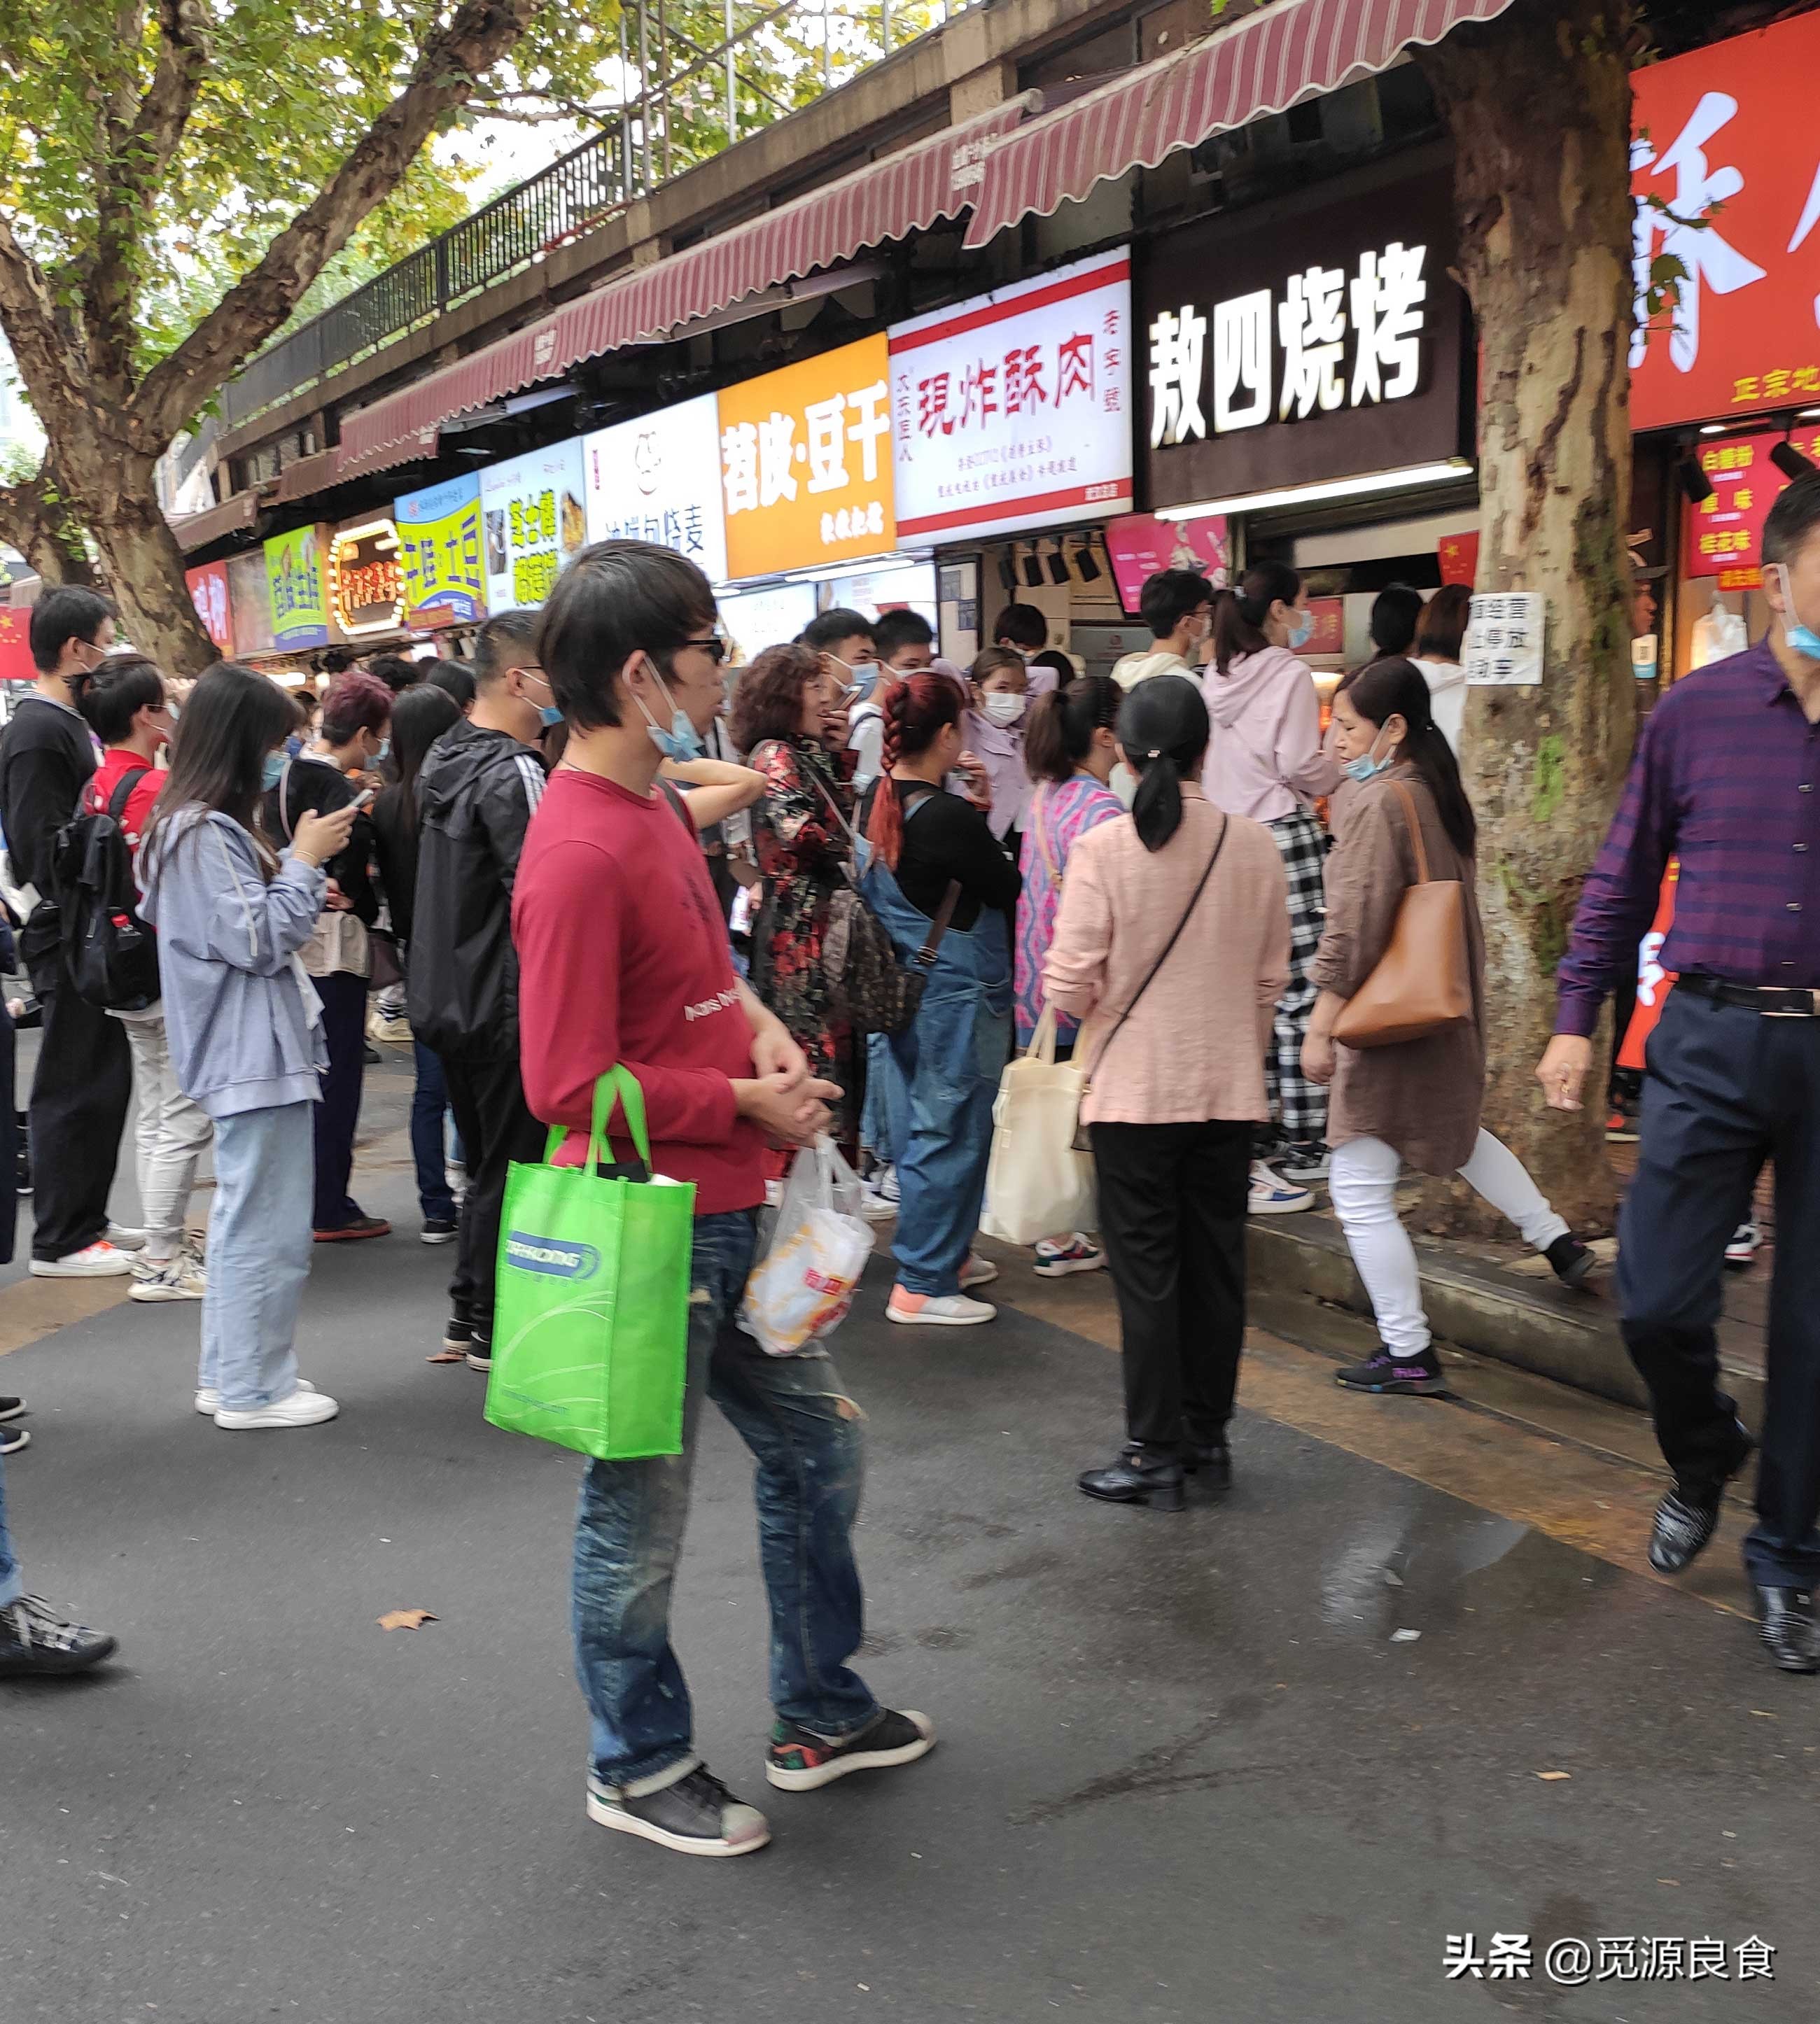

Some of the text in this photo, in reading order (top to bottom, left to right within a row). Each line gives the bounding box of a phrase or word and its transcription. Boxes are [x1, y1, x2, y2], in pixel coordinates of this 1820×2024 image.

[916, 332, 1096, 440] 現炸酥肉
[1149, 241, 1427, 449] 敖四烧烤
